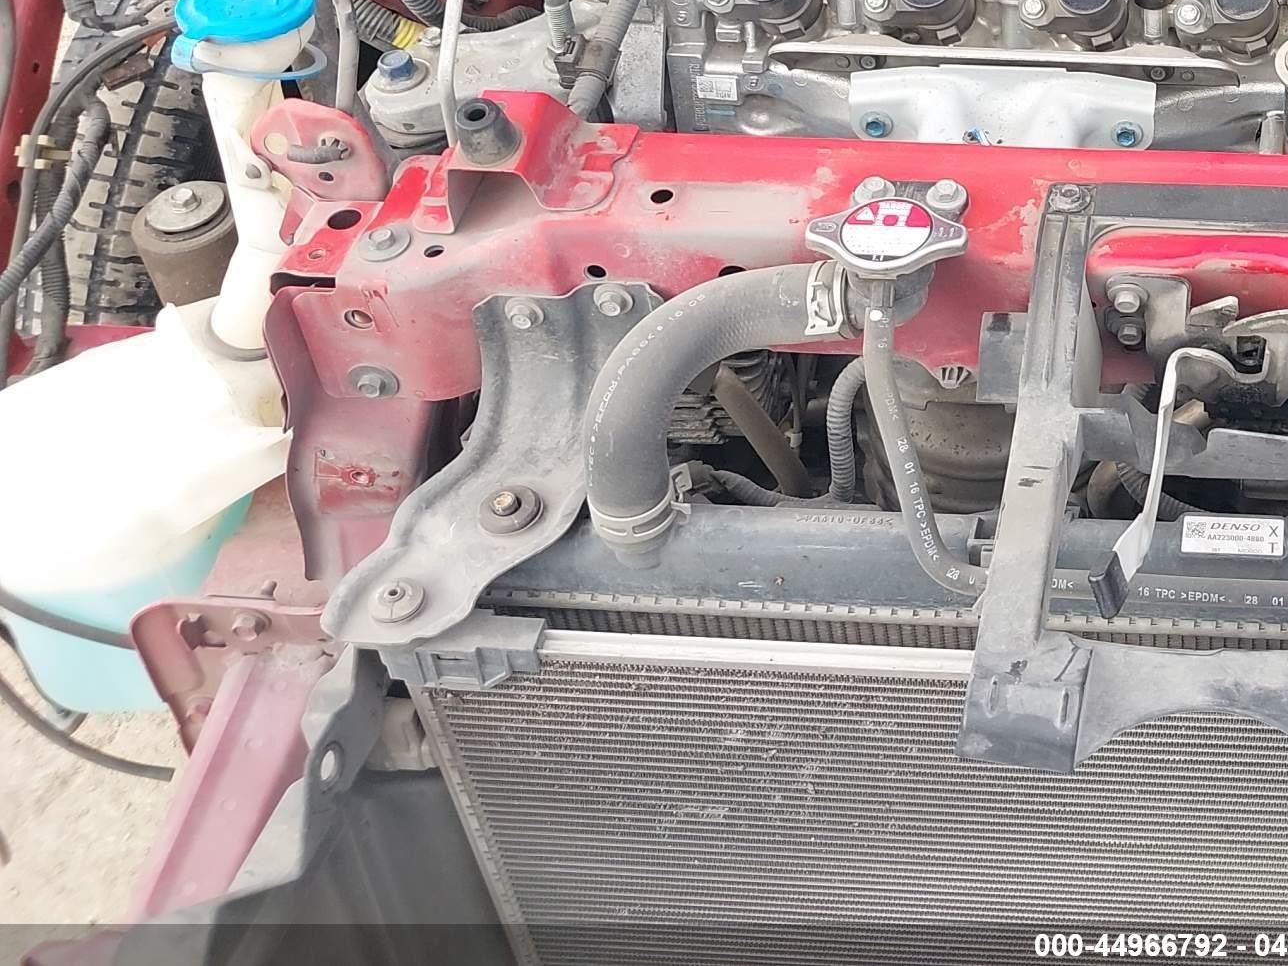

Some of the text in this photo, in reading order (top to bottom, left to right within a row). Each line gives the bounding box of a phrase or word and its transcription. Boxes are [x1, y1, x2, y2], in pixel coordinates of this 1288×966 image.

[904, 462, 915, 475] 01
[909, 482, 920, 495] 16
[913, 497, 927, 520] TPC
[1210, 522, 1279, 538] DENSO X
[920, 521, 940, 562] >EPDM<
[1267, 542, 1279, 554] T
[1138, 586, 1150, 597] 16
[1155, 588, 1176, 600] TPC
[1180, 591, 1226, 603] >EPDM<
[1272, 596, 1285, 607] 01
